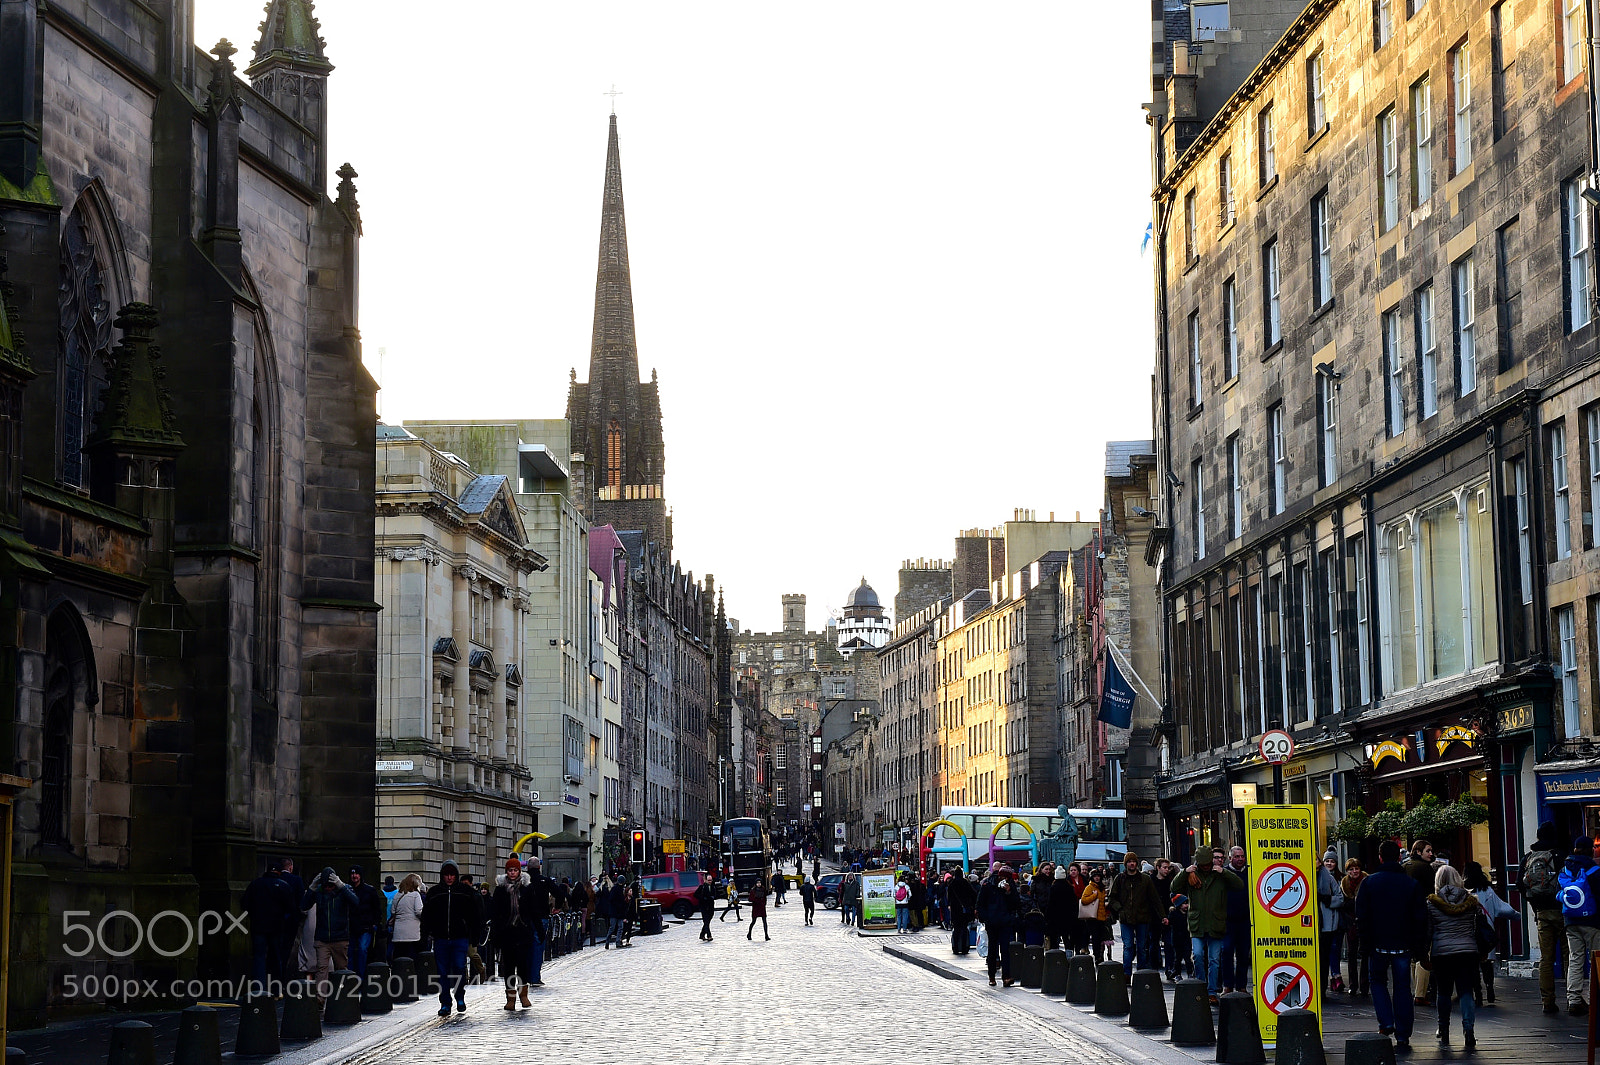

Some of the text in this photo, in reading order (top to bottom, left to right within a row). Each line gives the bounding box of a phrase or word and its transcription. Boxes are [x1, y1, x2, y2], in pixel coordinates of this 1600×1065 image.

[1504, 708, 1525, 728] 369
[1265, 739, 1289, 754] 20
[1544, 781, 1553, 793] The
[532, 792, 539, 800] D
[1251, 819, 1309, 829] BUSKERS
[1258, 839, 1304, 848] NO BUSKING
[1262, 851, 1301, 861] After 9pm
[1279, 925, 1290, 935] NO
[1256, 937, 1314, 947] AMPLIFICATION
[1264, 949, 1307, 959] At any time
